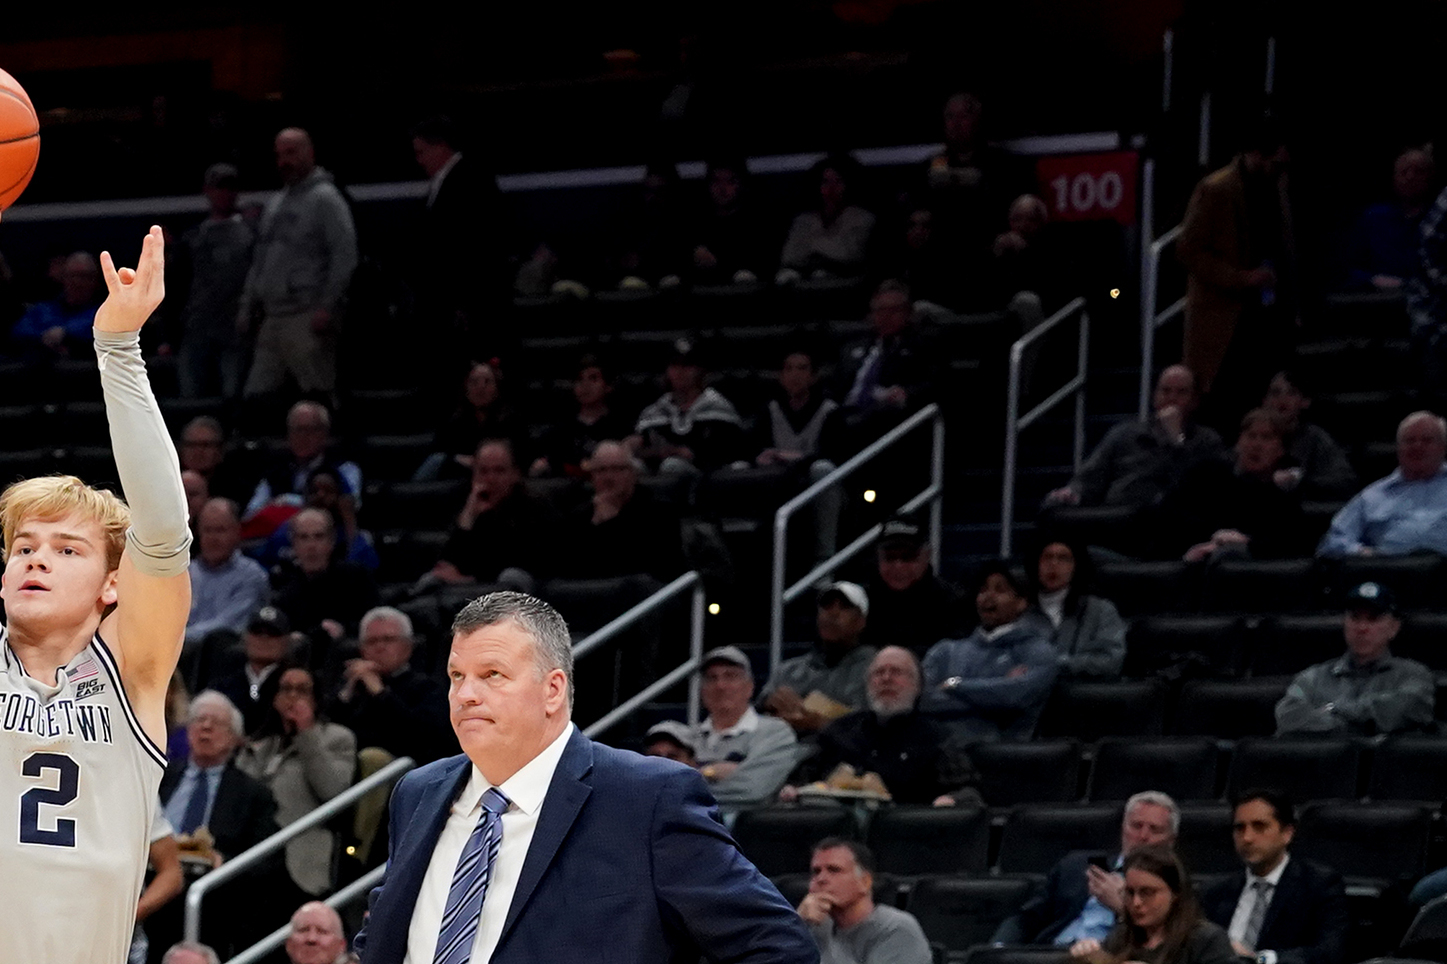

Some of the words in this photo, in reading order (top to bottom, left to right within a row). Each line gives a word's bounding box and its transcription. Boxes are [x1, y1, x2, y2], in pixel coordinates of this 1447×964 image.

[1050, 170, 1124, 214] 100
[75, 683, 106, 698] EAST
[77, 678, 98, 691] BIG
[18, 752, 80, 848] 2
